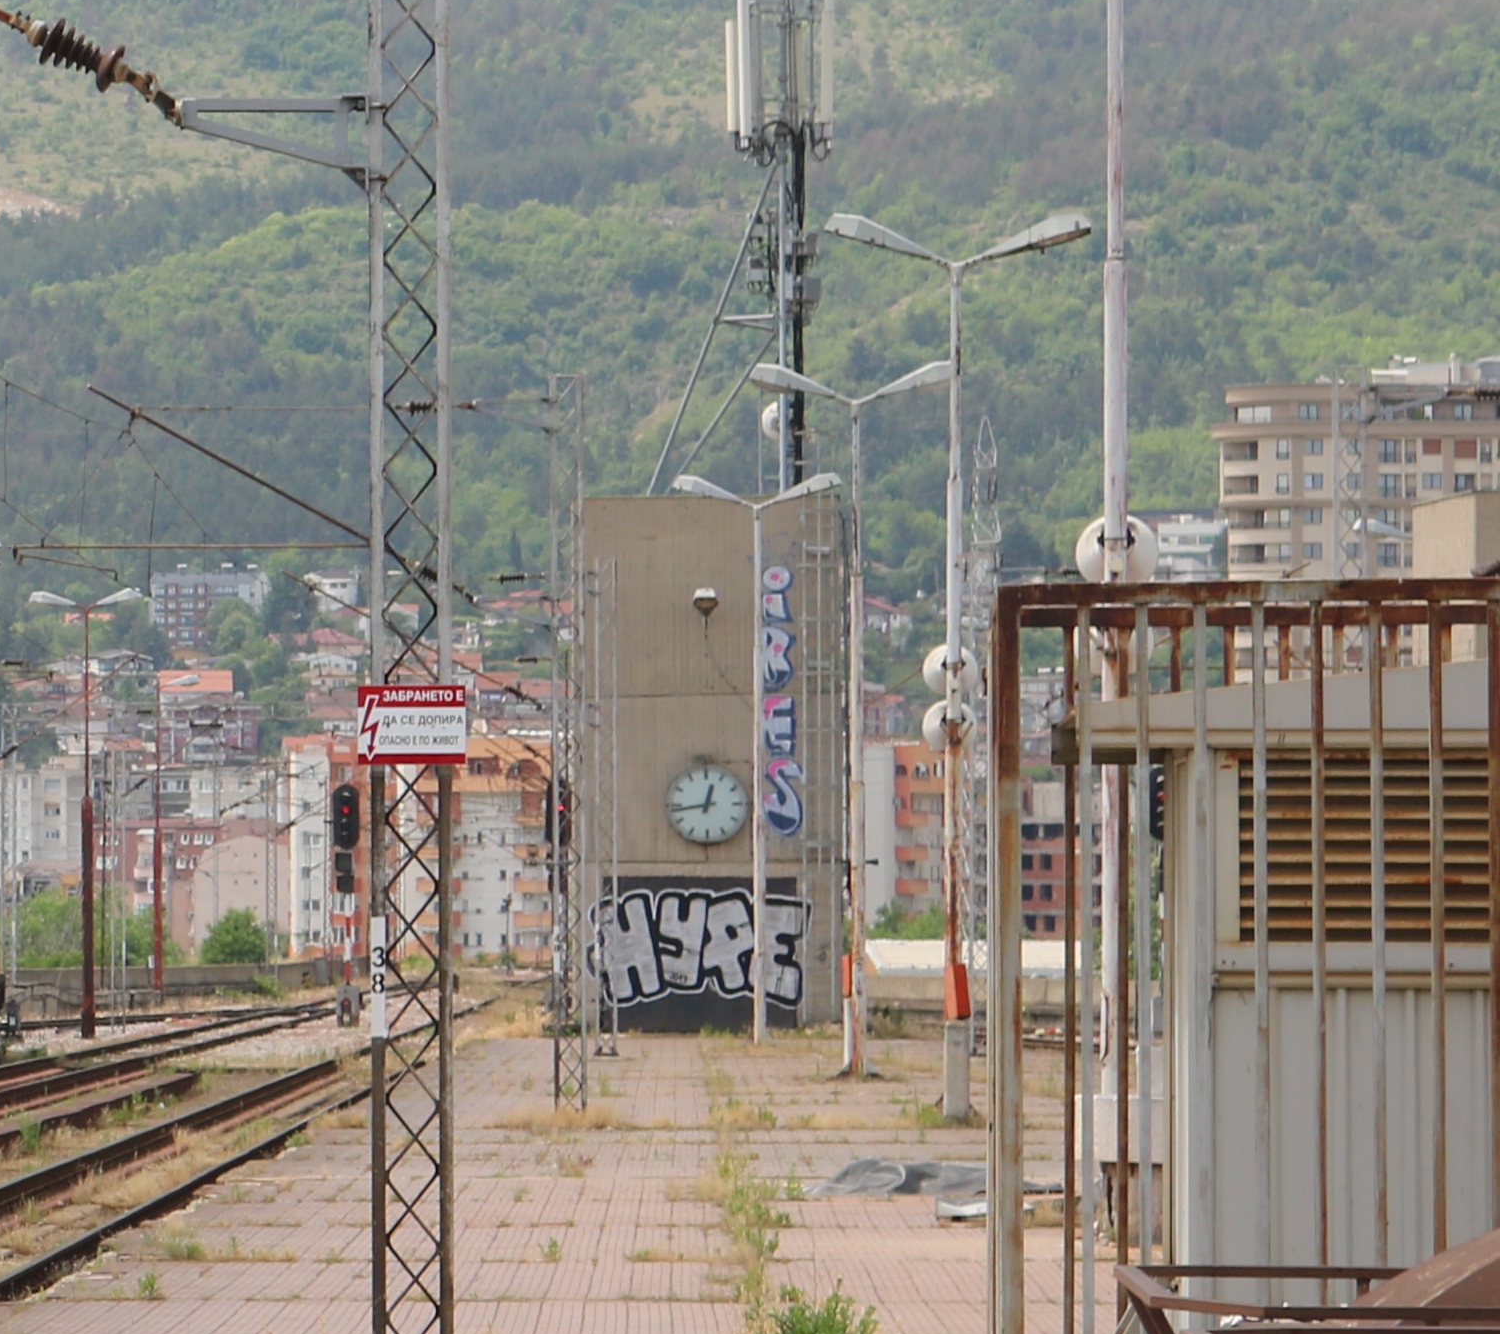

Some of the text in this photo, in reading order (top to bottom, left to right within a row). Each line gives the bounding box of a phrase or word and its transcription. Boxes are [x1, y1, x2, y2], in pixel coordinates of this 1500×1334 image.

[382, 690, 464, 702] ЗАБРАНЕТО Е
[382, 715, 463, 726] ДА СЕ ДОПИРА
[379, 735, 459, 746] ОПАСНО Е ПО ЖИВОТ
[588, 888, 812, 1009] HYPE
[372, 946, 386, 994] 38
